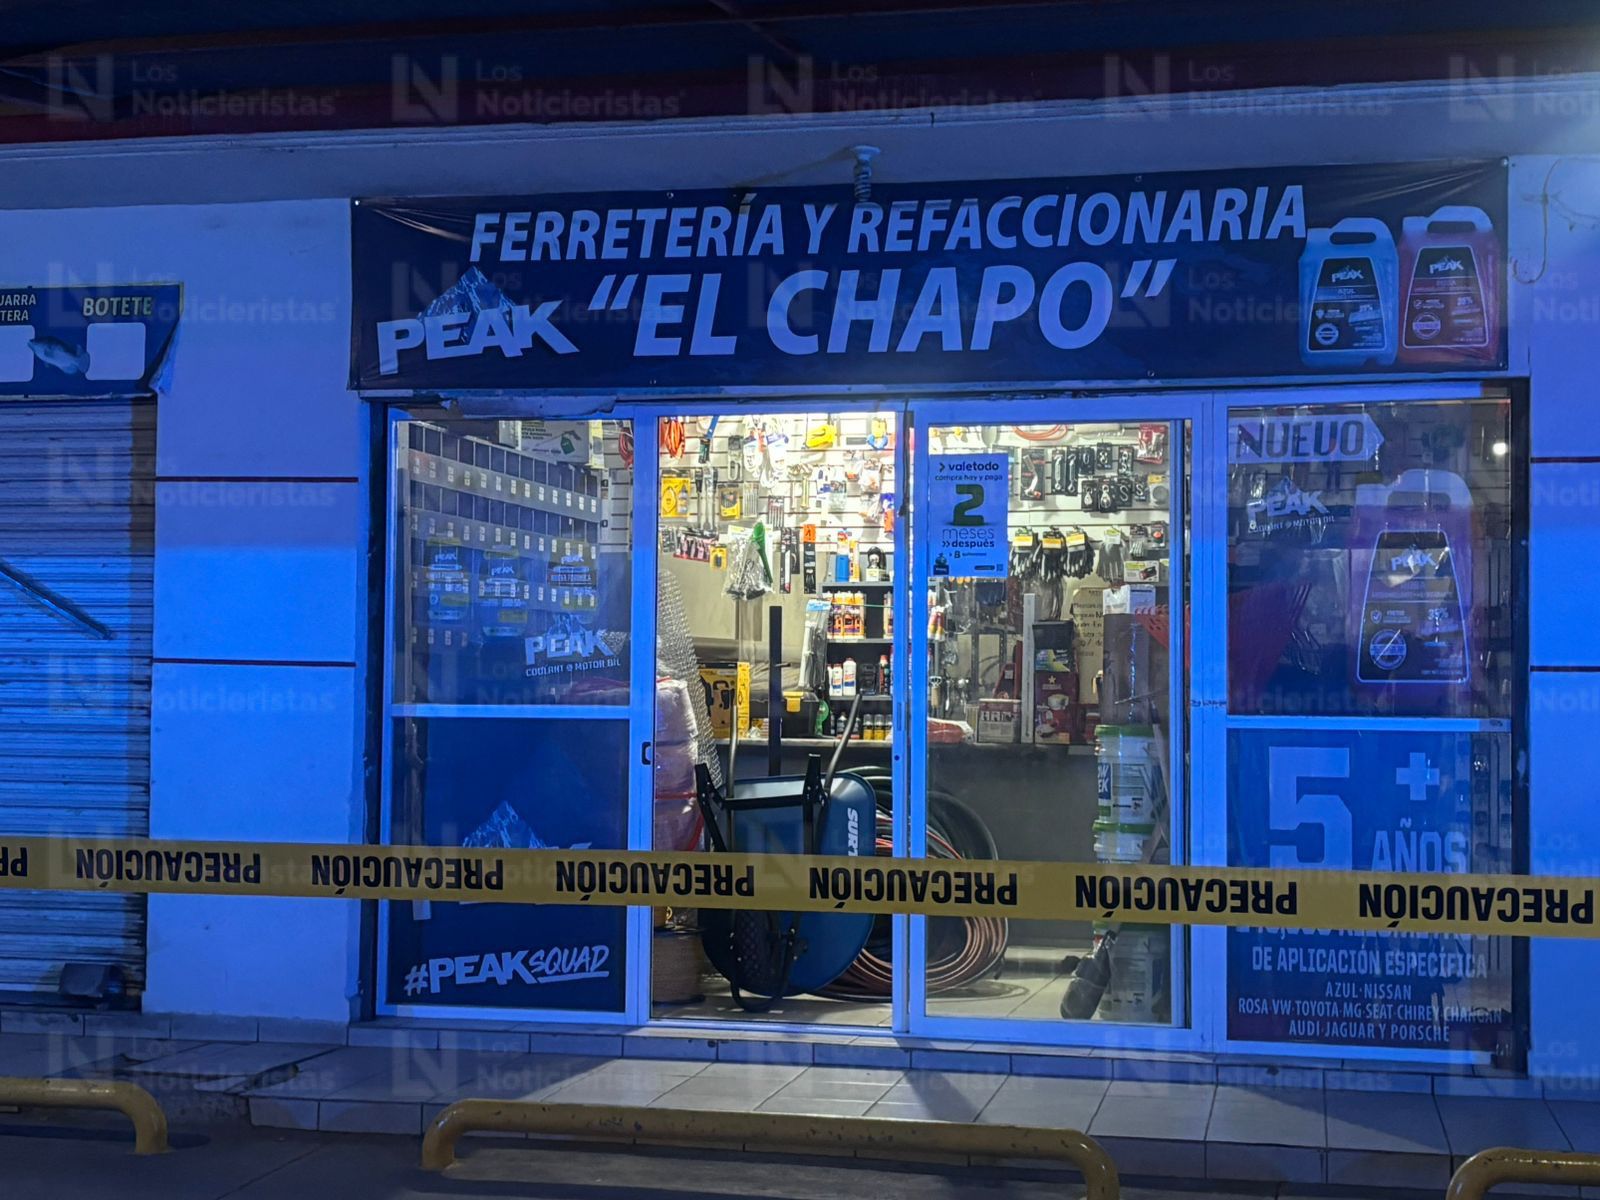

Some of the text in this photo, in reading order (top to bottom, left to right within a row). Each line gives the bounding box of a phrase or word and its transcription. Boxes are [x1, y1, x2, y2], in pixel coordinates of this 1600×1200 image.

[469, 184, 1306, 262] FERRETERÍA Y REFACCIONARIA
[1331, 269, 1364, 283] PEAK
[1429, 259, 1464, 274] PEAK
[0, 309, 29, 322] TERA
[83, 296, 153, 317] BOTETE
[376, 299, 581, 376] PEAK
[948, 461, 999, 472] valetodo
[952, 483, 985, 527] 2
[1246, 489, 1331, 523] PEAK
[942, 528, 995, 540] meses
[524, 629, 616, 666] PEAK
[575, 660, 605, 672] MOTOR
[1269, 746, 1352, 869] 5
[1370, 817, 1469, 873] AÑOS
[76, 848, 261, 888] PRECAUCIÓN
[311, 854, 504, 895] PRECAUCIÓN
[556, 860, 755, 901] PRECAUCIÓN
[809, 866, 1018, 909] PRECAUCIÓN
[1075, 875, 1297, 918] PRECAUCIÓN
[1359, 883, 1594, 928] PRECAUCIÓN
[403, 944, 609, 997] #PEAKSQUAD
[1252, 943, 1488, 979] DE APLICACIÓN ESPECÍFICA
[1378, 1023, 1387, 1040] Y
[1390, 1024, 1450, 1042] PORSCHE
